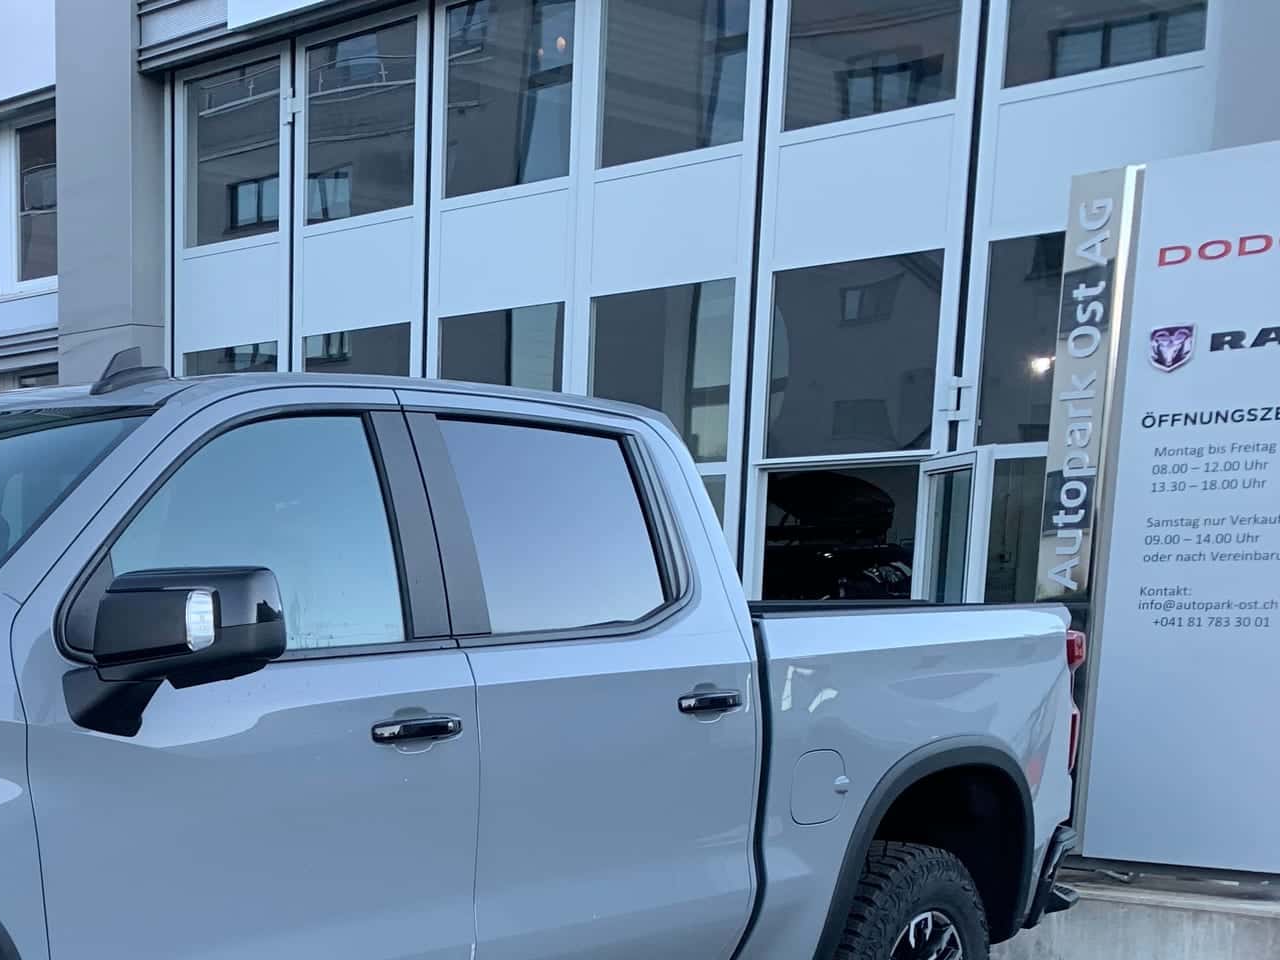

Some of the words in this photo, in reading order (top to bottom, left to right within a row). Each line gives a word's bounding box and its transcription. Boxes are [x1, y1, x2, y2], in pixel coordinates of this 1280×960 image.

[1075, 197, 1113, 267] AG
[1158, 233, 1280, 267] DOD
[1067, 280, 1107, 359] Ost
[1153, 446, 1205, 458] Montag
[1208, 443, 1227, 455] bis
[1230, 441, 1277, 455] Freitag
[1151, 463, 1189, 476] 08.00
[1203, 460, 1240, 473] 12.00
[1244, 458, 1270, 471] Uhr
[1047, 370, 1097, 591] Autopark
[1151, 481, 1187, 493] 13.30
[1201, 479, 1239, 491] 18.00
[1242, 477, 1267, 489] Uhr
[1146, 516, 1200, 529] Samstag
[1203, 517, 1227, 526] nur
[1144, 534, 1181, 546] 09.00
[1195, 533, 1232, 545] 14.00
[1235, 531, 1260, 544] Uhr
[1143, 551, 1172, 562] oder
[1175, 551, 1206, 562] nach
[1139, 585, 1192, 597] Kontakt:
[1138, 599, 1278, 612] info@autopark-ost.ch
[1152, 616, 1183, 627] +041
[1186, 616, 1202, 627] 81
[1207, 616, 1231, 627] 783
[1234, 616, 1251, 627] 30
[1254, 616, 1270, 627] 01
